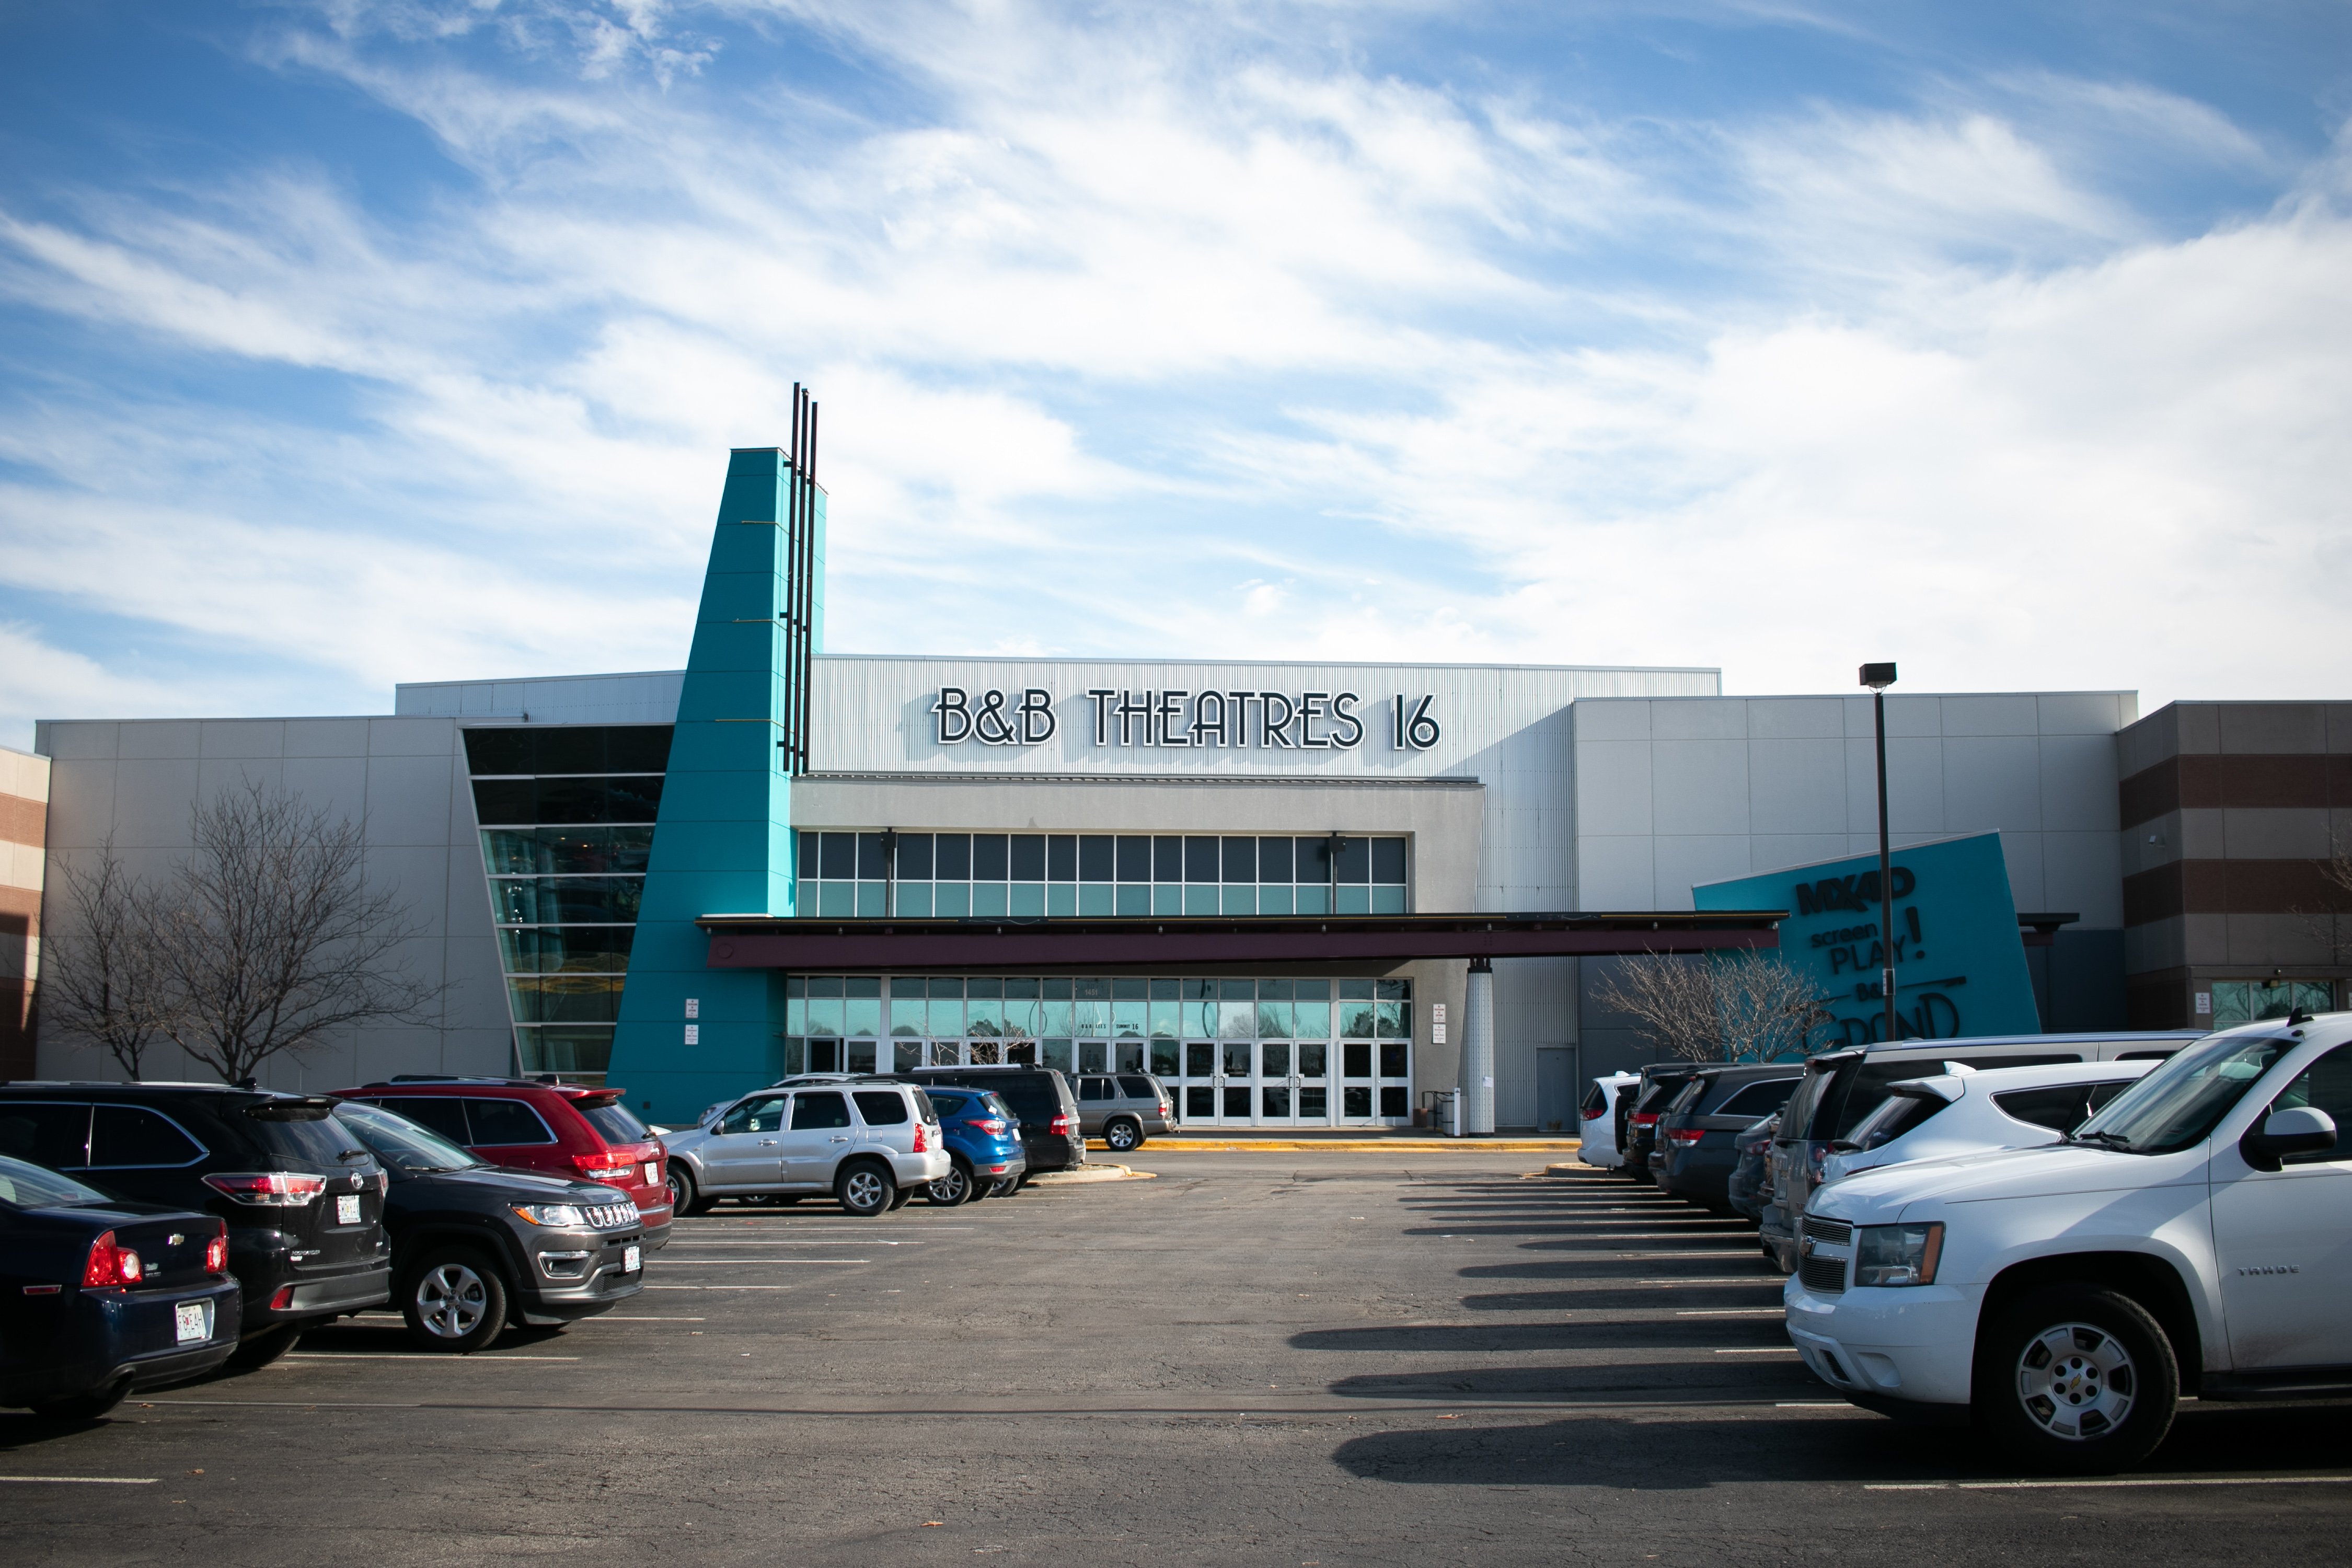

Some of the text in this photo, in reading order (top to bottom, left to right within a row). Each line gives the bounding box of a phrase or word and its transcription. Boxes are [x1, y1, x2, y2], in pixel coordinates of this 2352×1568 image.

[930, 685, 1442, 751] B&B THEATRES 16
[1795, 867, 1915, 915] MX4D
[1810, 923, 1878, 947] screen
[1855, 982, 1885, 1002] B&
[2237, 1264, 2300, 1276] TAHOE
